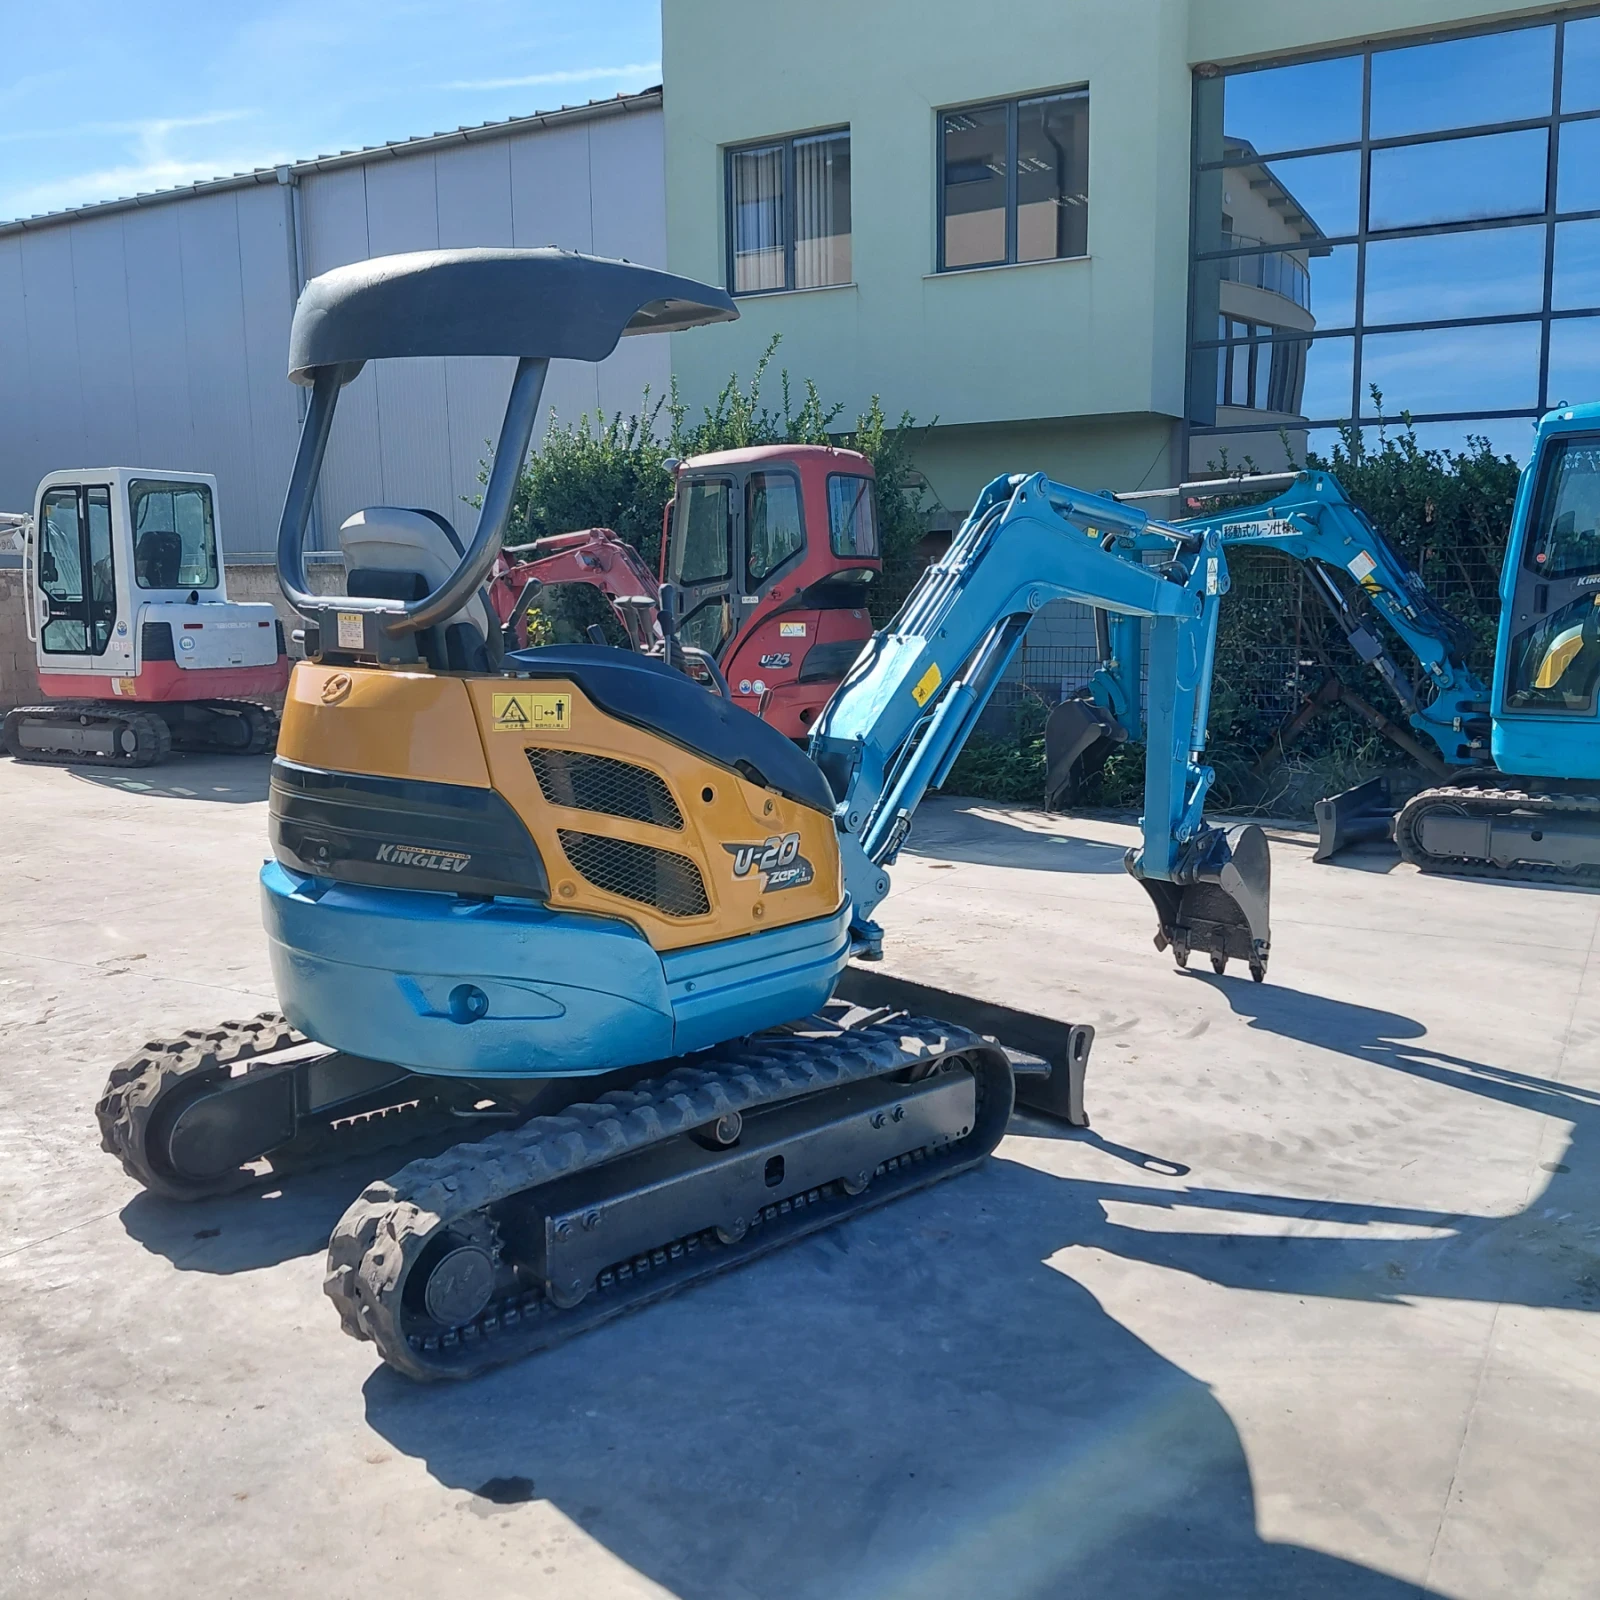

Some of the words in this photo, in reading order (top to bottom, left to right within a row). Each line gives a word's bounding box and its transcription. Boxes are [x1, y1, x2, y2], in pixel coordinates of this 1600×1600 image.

[761, 653, 790, 665] U-25
[375, 843, 470, 872] KINGLEV
[735, 834, 799, 874] U-20
